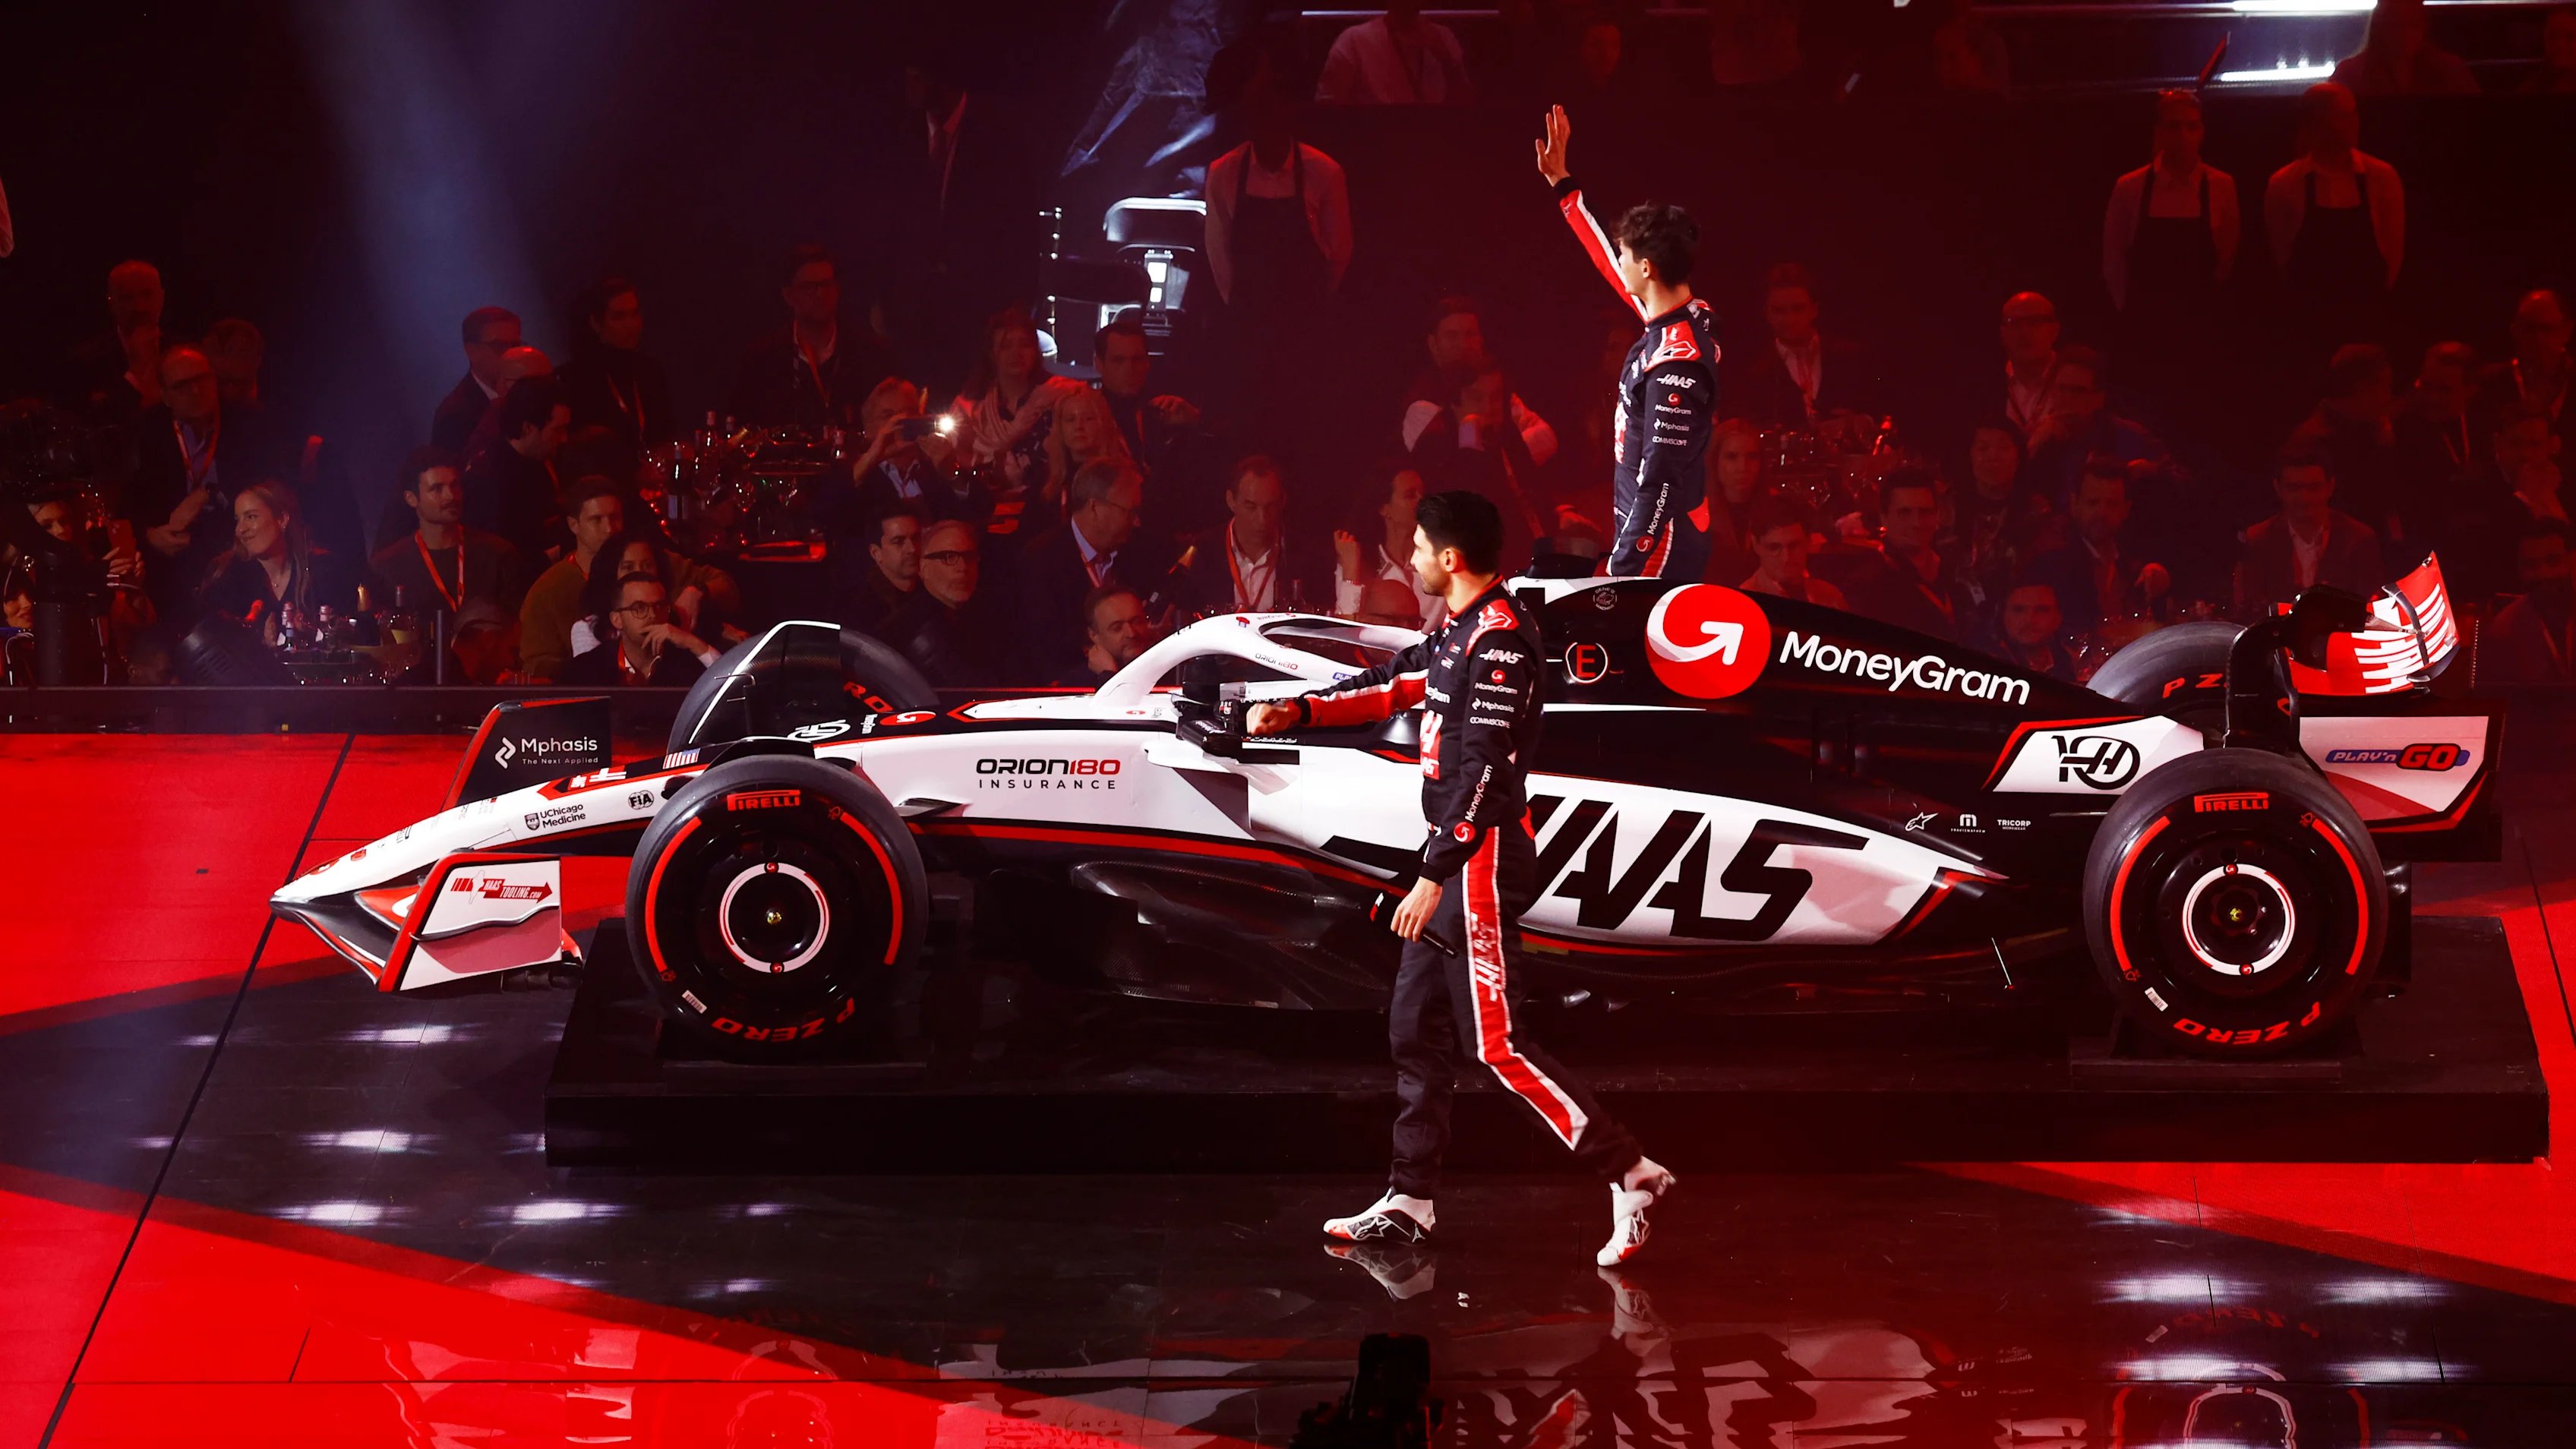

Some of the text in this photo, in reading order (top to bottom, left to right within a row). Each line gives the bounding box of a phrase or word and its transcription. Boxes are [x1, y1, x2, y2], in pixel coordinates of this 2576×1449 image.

[1656, 374, 1696, 388] HAAS
[1655, 404, 1691, 415] MoneyGram
[1647, 482, 1669, 535] MoneyGram
[1479, 649, 1524, 665] HAAS
[1576, 645, 1596, 677] E
[1779, 630, 2030, 706] MoneyGram
[844, 681, 894, 713] RO
[1474, 683, 1517, 695] MoneyGram
[1482, 701, 1515, 713] Mphasis
[521, 736, 598, 756] Mphasis
[565, 757, 598, 766] Applied
[2399, 744, 2458, 769] GO
[976, 758, 1121, 775] ORION180
[979, 779, 1116, 790] INSURANCE
[1464, 764, 1493, 822] MoneyGram
[727, 789, 801, 811] PIRELLI
[2194, 792, 2269, 813] PIRELLI
[540, 803, 584, 819] UChicago
[542, 812, 586, 829] Medicine
[1997, 819, 2031, 827] TRICORP
[483, 879, 502, 890] HAAS
[711, 997, 855, 1042] P ZERO
[2173, 1001, 2320, 1044] P ZERO
